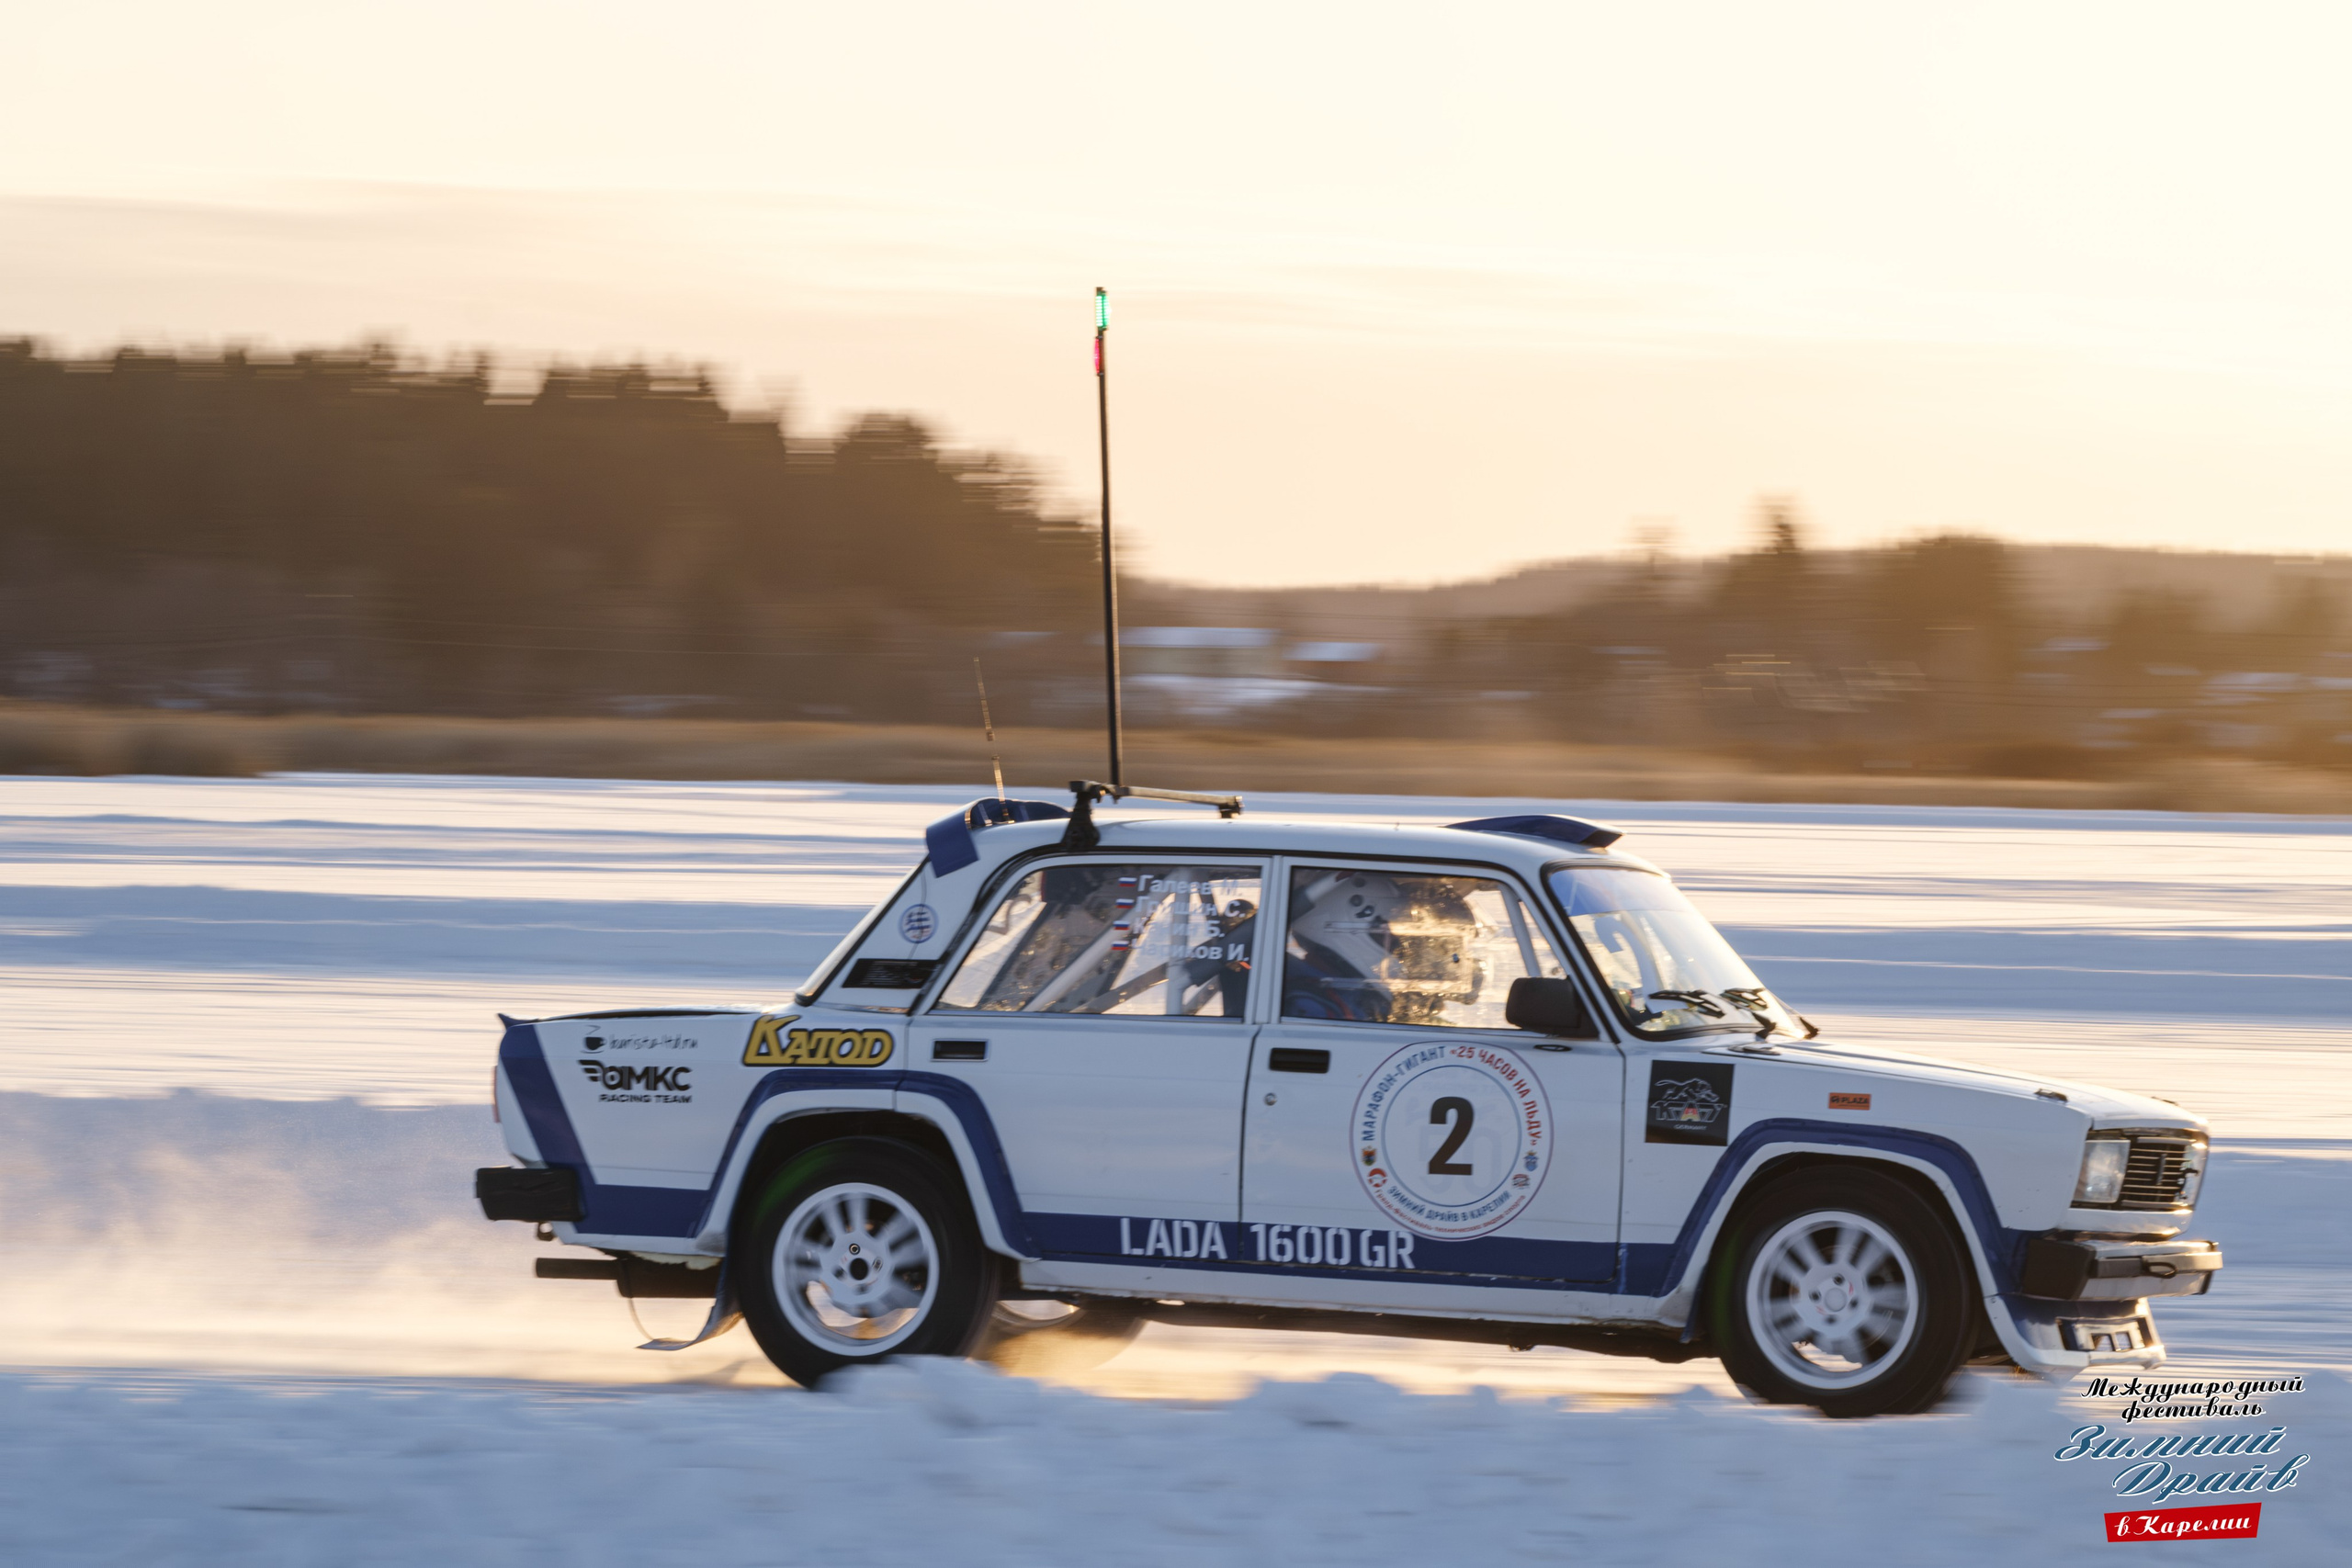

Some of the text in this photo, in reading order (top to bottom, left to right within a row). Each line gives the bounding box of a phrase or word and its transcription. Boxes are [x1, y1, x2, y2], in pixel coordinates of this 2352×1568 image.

[1137, 874, 1212, 896] Галеев
[1225, 899, 1246, 918] С.
[1206, 919, 1226, 937] Б.
[1227, 942, 1250, 961] И.
[599, 1094, 692, 1103] RACING TEAM
[1362, 1045, 1446, 1141] МАРАФОН-ГИГАНТ
[1477, 1049, 1519, 1081] ЧАСОВ
[1512, 1078, 1532, 1099] НА
[1429, 1096, 1475, 1176] 2
[1425, 1209, 1460, 1222] ДРАЙВ
[1120, 1217, 1228, 1259] LADA
